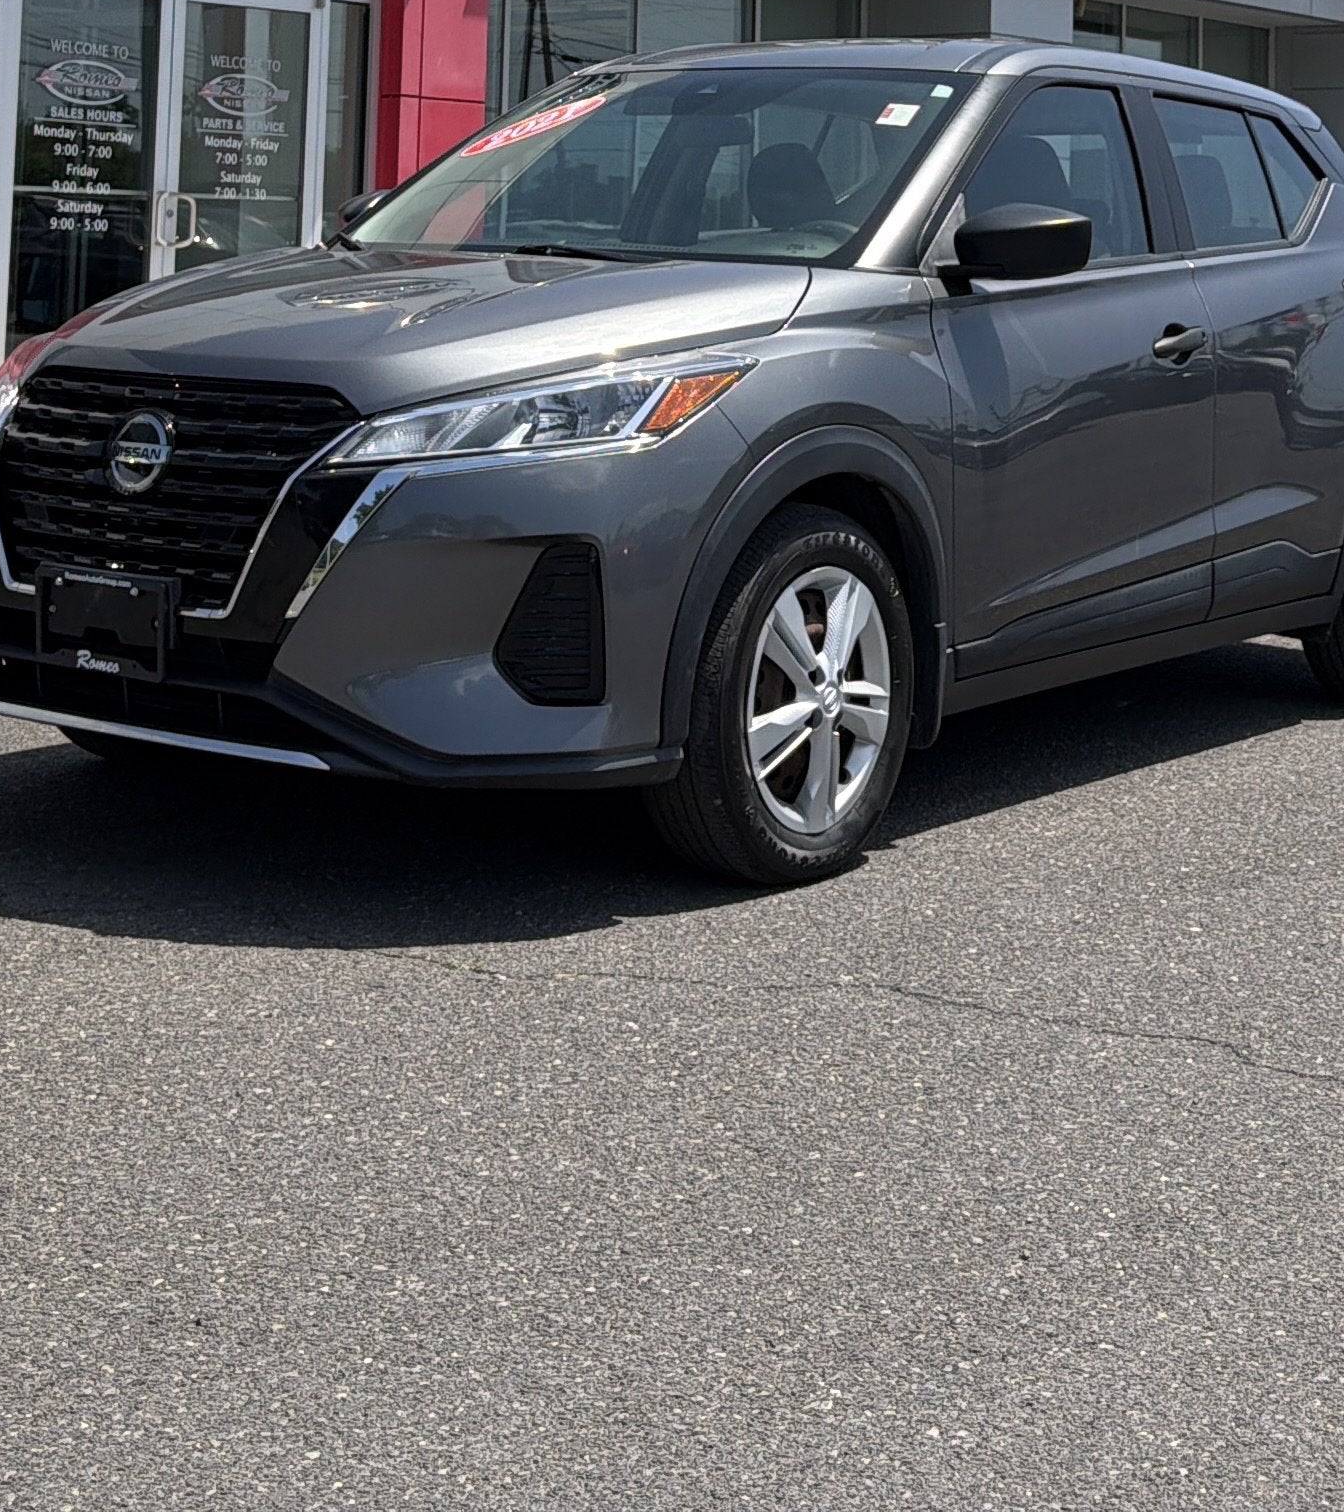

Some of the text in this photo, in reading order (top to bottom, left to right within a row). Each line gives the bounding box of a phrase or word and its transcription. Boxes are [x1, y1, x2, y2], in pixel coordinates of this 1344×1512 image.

[50, 39, 129, 60] WELCOME TO
[267, 59, 282, 73] TO
[64, 86, 111, 99] NISSAN
[216, 76, 275, 98] Roo
[50, 105, 123, 123] SALES HOURS
[202, 117, 234, 130] PARTS
[236, 119, 243, 130] &
[33, 124, 77, 142] Monday
[85, 127, 135, 146] Thursday
[53, 143, 79, 157] 9:00
[87, 145, 113, 159] 7:00
[204, 135, 244, 151] Monday
[250, 138, 280, 153] Friday
[215, 151, 238, 166] 7:00
[246, 154, 268, 167] 5:00
[65, 163, 100, 180] Friday
[220, 170, 263, 187] Saturday
[52, 179, 77, 194] 9:00
[85, 181, 111, 196] 6:00
[214, 186, 237, 200] 7:00
[245, 188, 267, 201] 1:30
[56, 199, 105, 217] Saturday
[49, 217, 75, 231] 9:00
[83, 218, 109, 232] 5:00
[113, 445, 161, 460] NISSAN
[76, 649, 121, 674] Romeo
